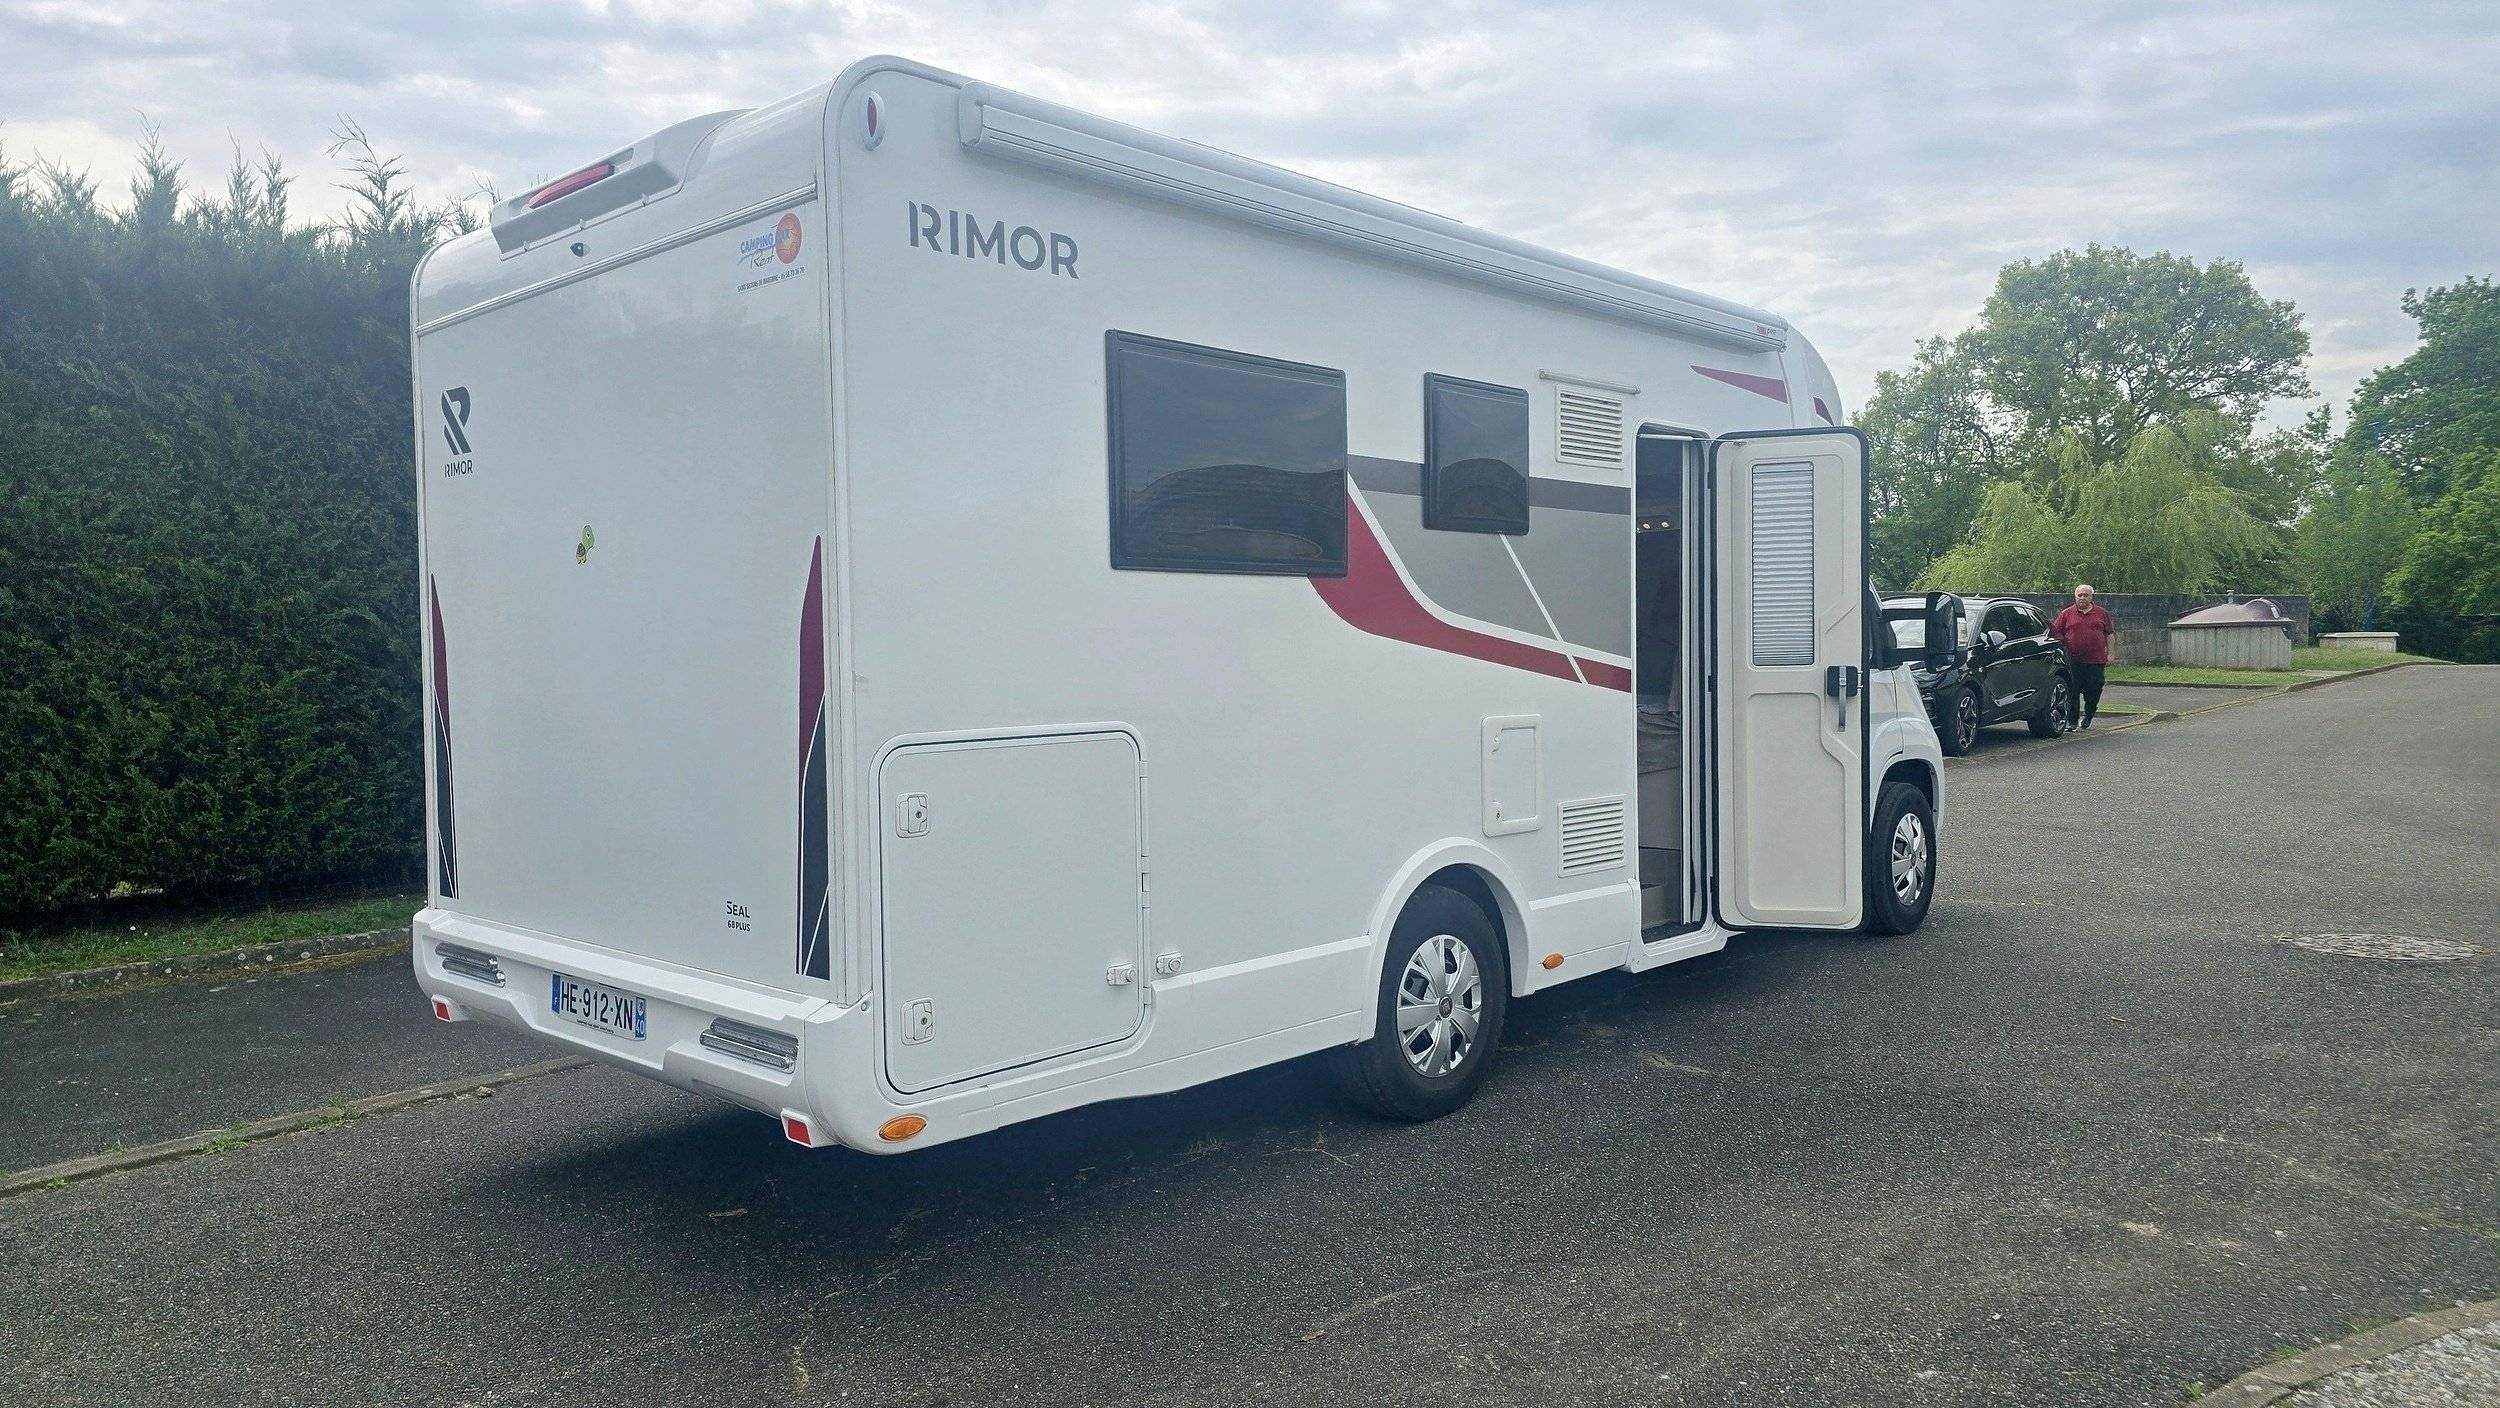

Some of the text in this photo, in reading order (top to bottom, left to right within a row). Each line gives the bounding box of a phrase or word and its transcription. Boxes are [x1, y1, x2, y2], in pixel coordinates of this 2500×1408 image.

[741, 232, 774, 254] CAMPING
[908, 200, 1080, 280] RIMOR
[444, 459, 473, 478] RIMOR
[726, 900, 751, 918] SEAL
[560, 980, 634, 1031] HE-912-XN
[635, 1019, 646, 1036] 40
